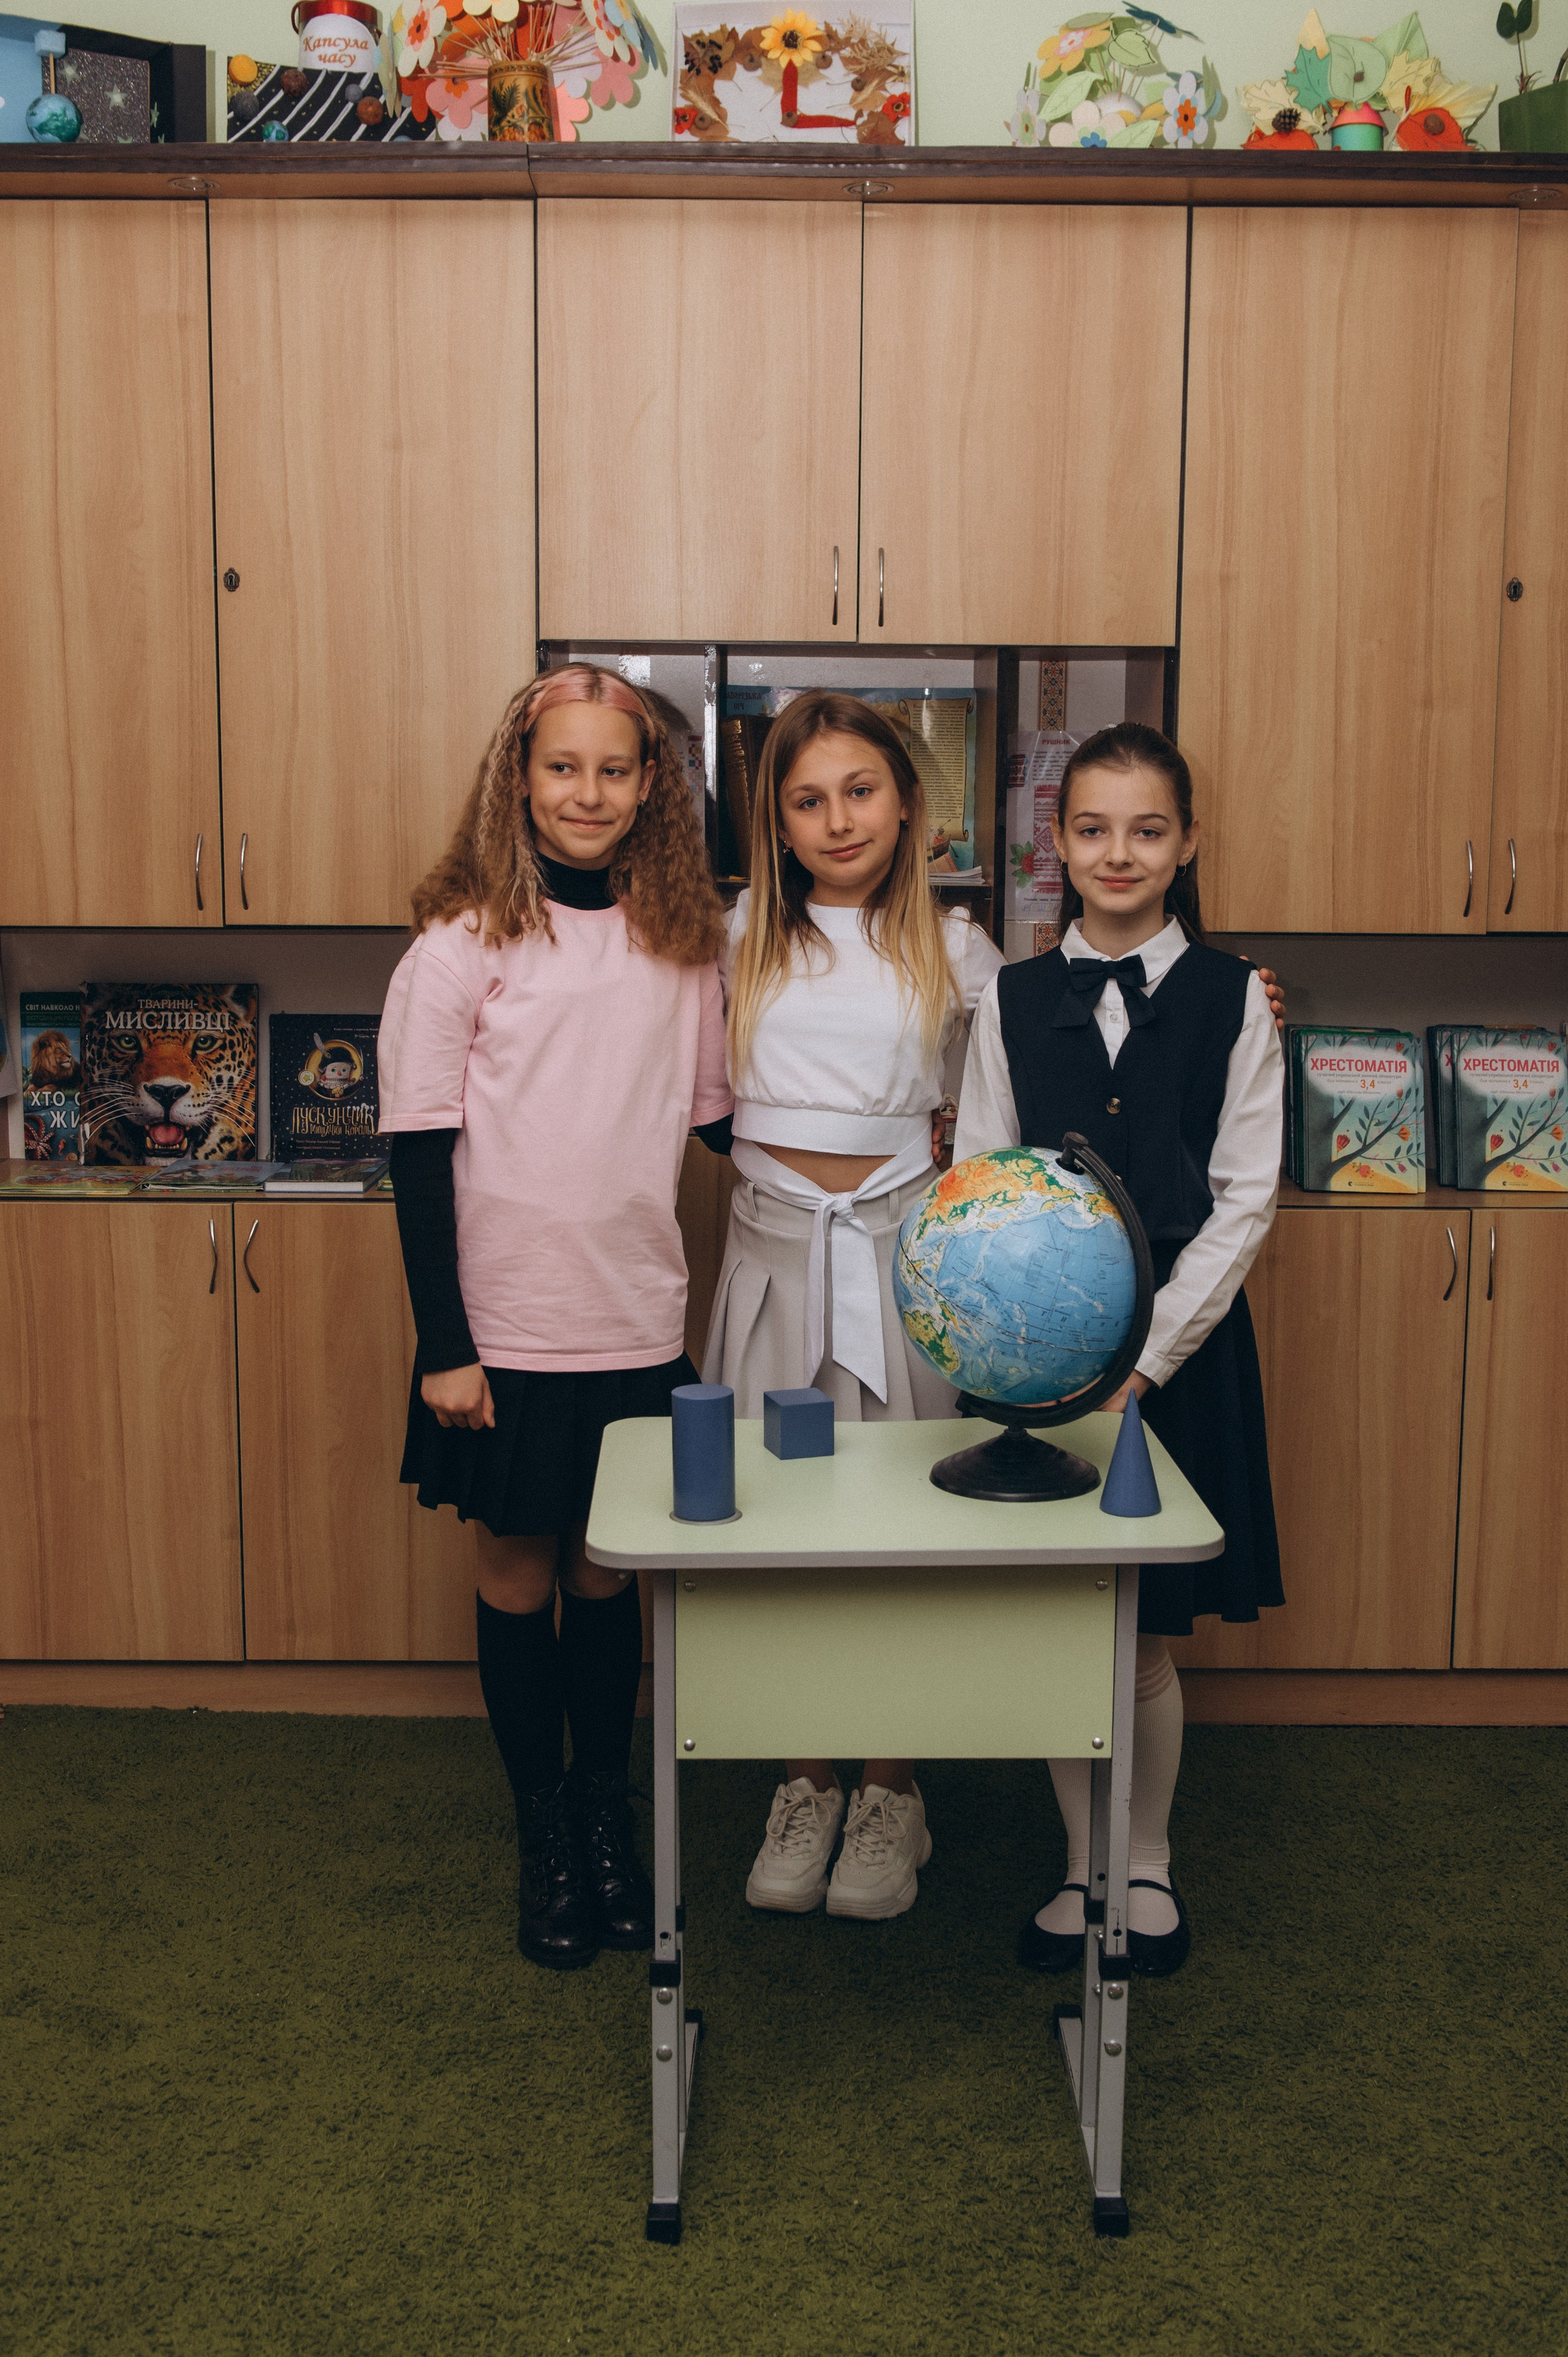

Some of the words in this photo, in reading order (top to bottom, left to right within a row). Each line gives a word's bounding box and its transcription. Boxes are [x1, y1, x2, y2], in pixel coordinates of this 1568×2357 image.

[303, 36, 369, 52] Капсула
[318, 53, 356, 68] часу
[138, 999, 198, 1009] ТВАРИНИ-
[105, 1011, 231, 1033] МИСЛИВЦІ
[1310, 1058, 1407, 1073] ХРЕСТОМАТІЯ
[1463, 1058, 1559, 1073] ХРЕСТОМАТІЯ
[1360, 1079, 1375, 1090] 3,4
[1513, 1079, 1528, 1090] 3,4
[31, 1091, 66, 1106] ХТО
[290, 1103, 377, 1135] ЛУСКУНЧИК
